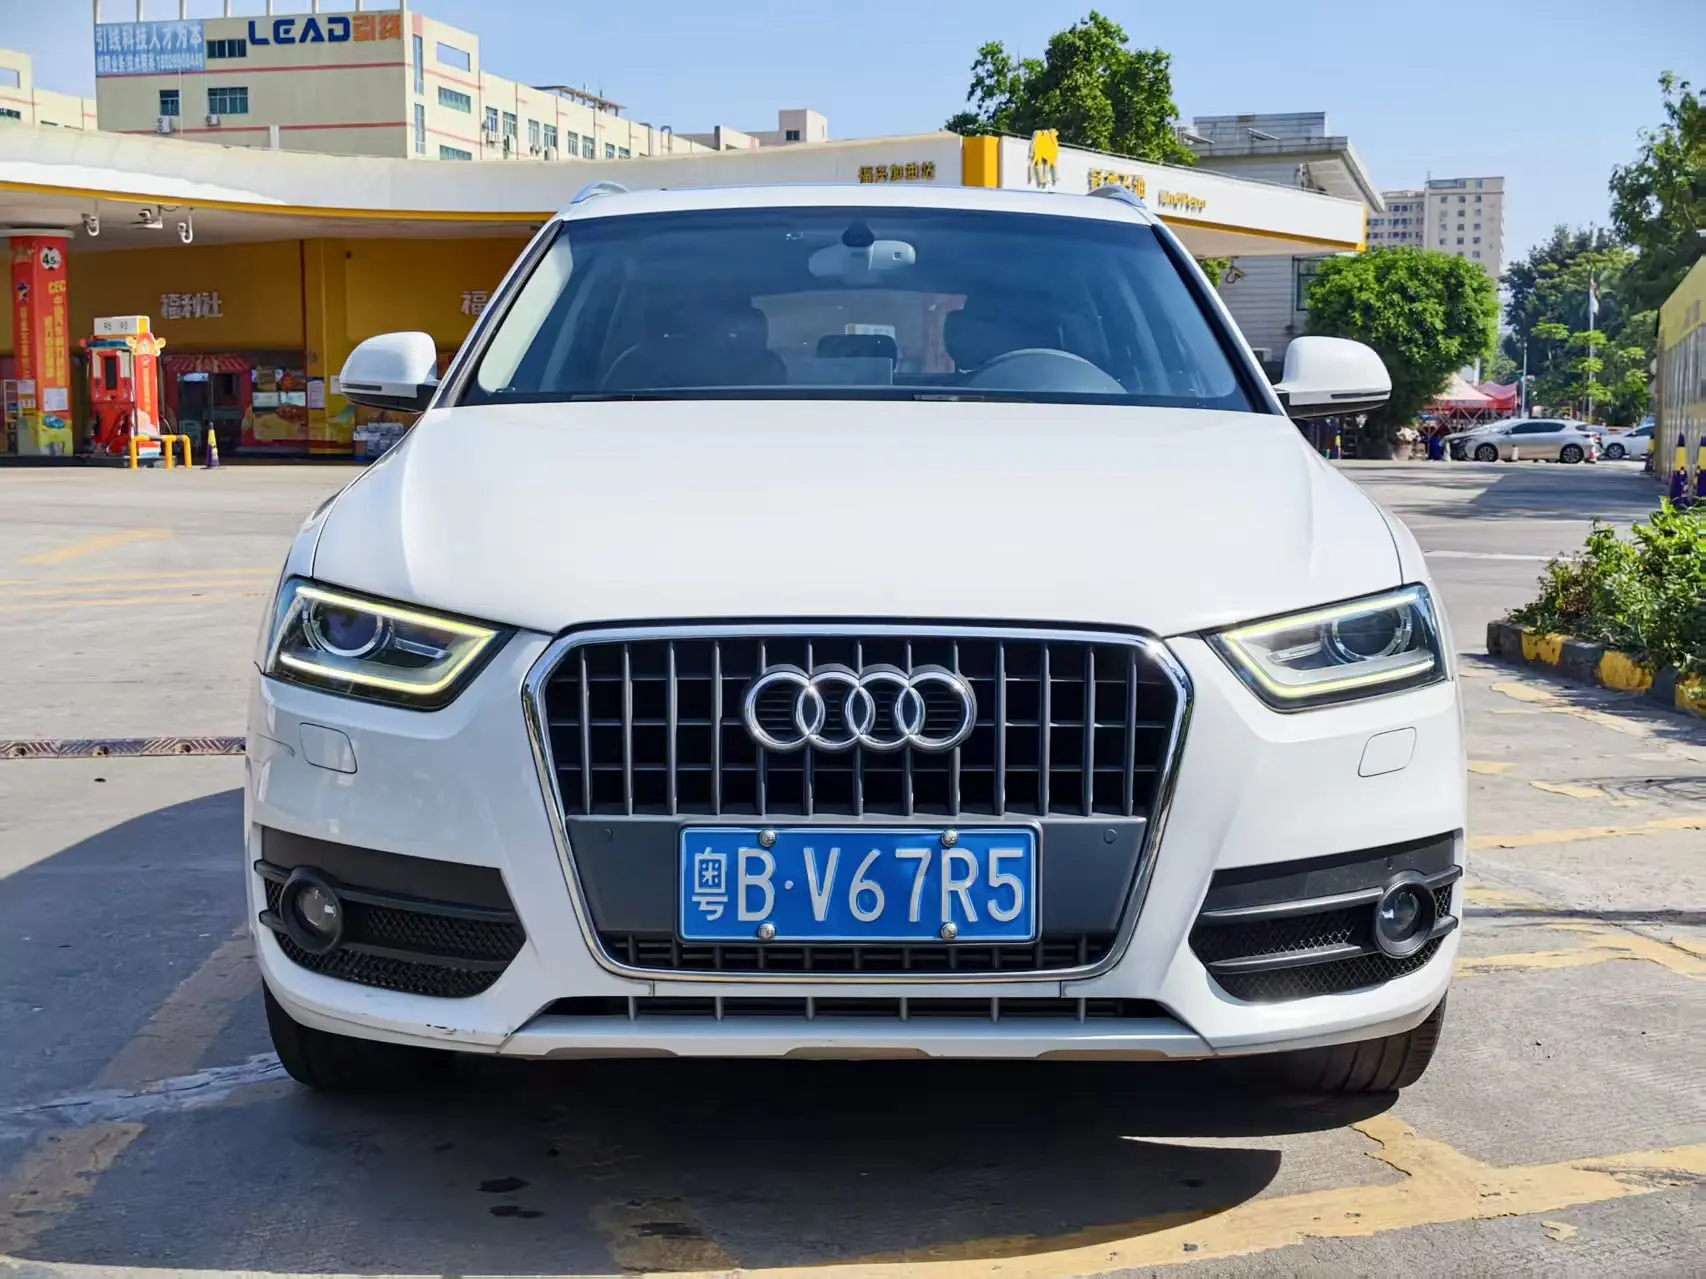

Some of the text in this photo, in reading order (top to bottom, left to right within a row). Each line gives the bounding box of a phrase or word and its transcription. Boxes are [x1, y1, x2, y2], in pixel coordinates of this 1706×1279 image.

[248, 16, 350, 45] LEAD
[160, 291, 223, 319] 福利社
